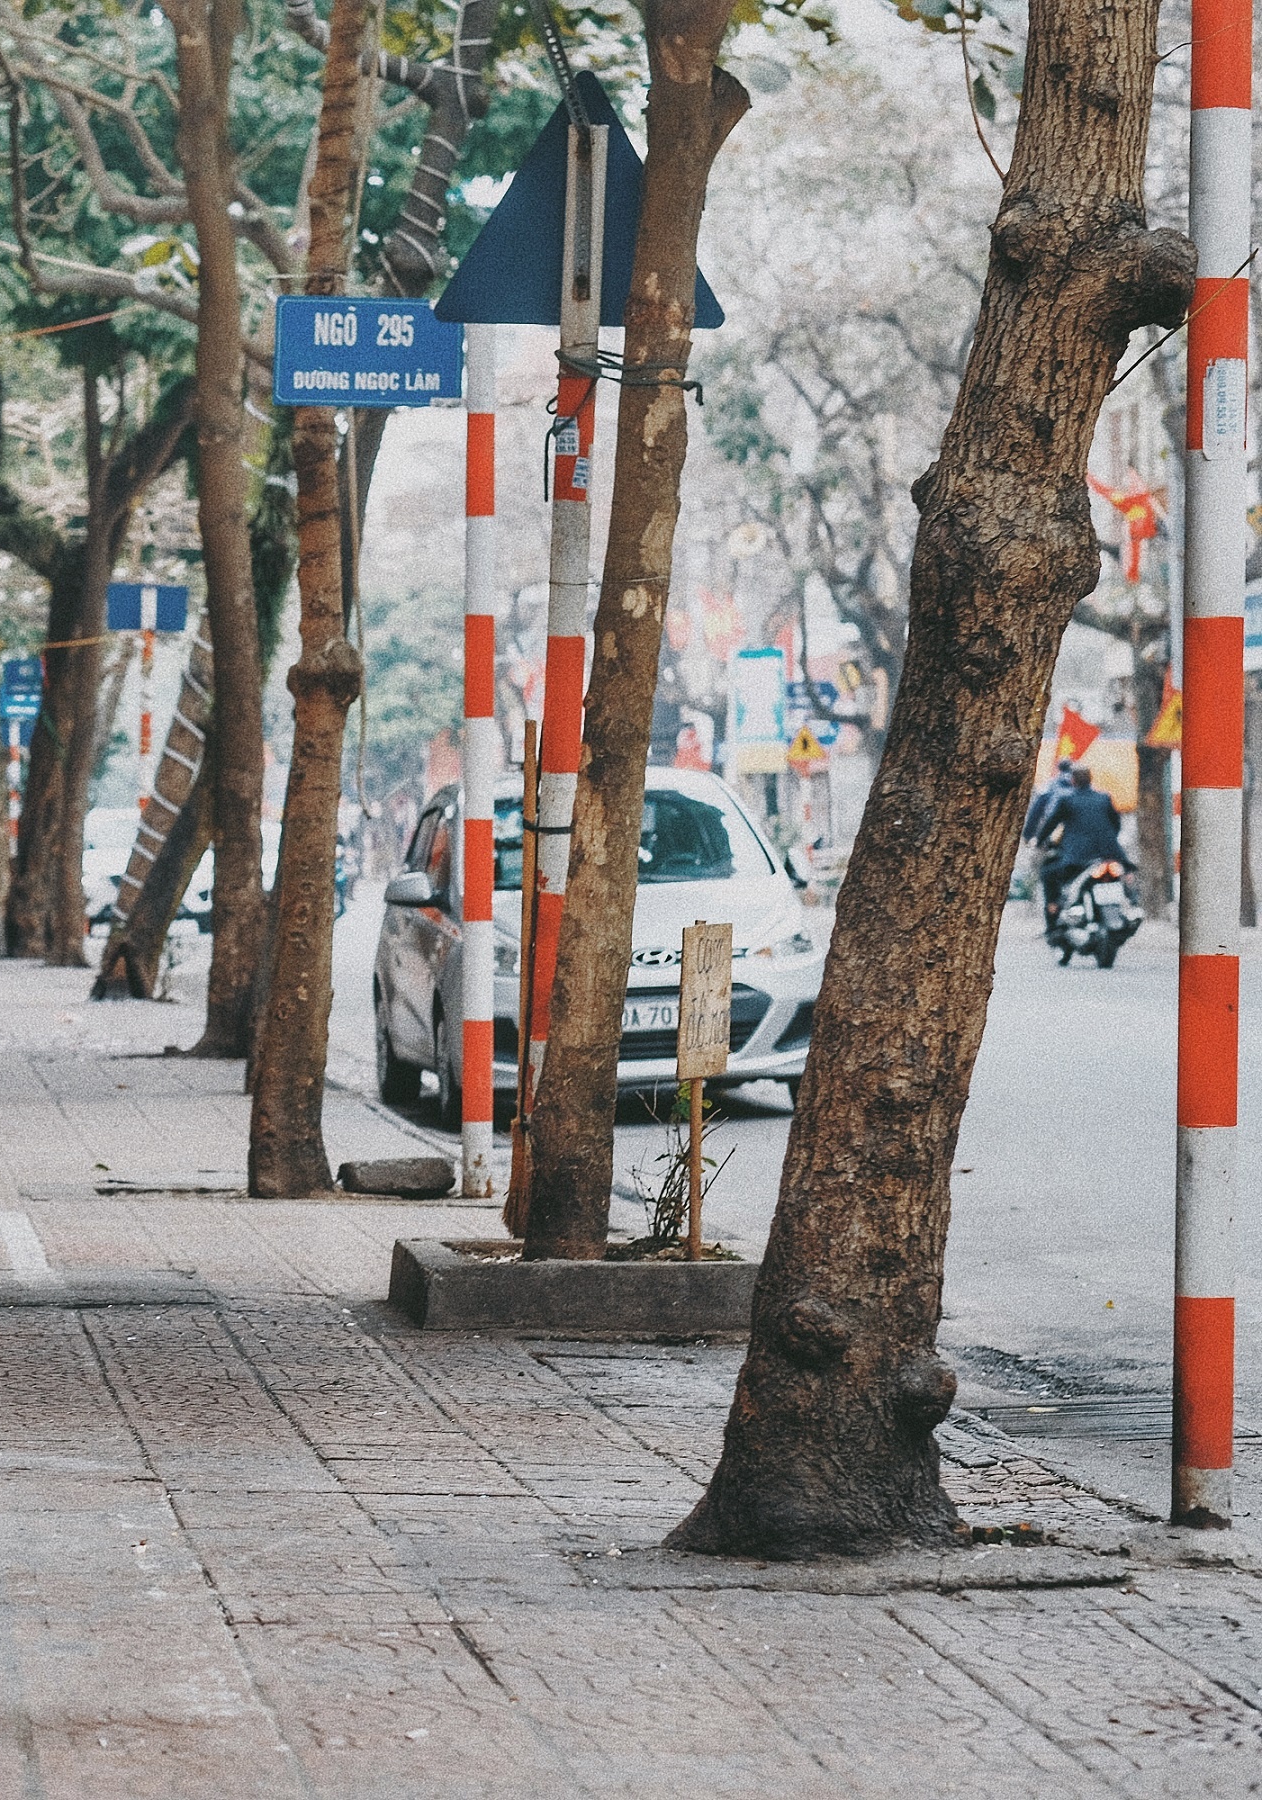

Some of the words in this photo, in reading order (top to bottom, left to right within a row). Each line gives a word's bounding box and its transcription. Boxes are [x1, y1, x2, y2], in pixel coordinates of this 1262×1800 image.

[314, 306, 357, 346] NGÕ
[376, 314, 414, 347] 295
[293, 366, 350, 390] ĐƯỜNG
[354, 371, 400, 395] NGỌC
[405, 368, 440, 391] LÂM
